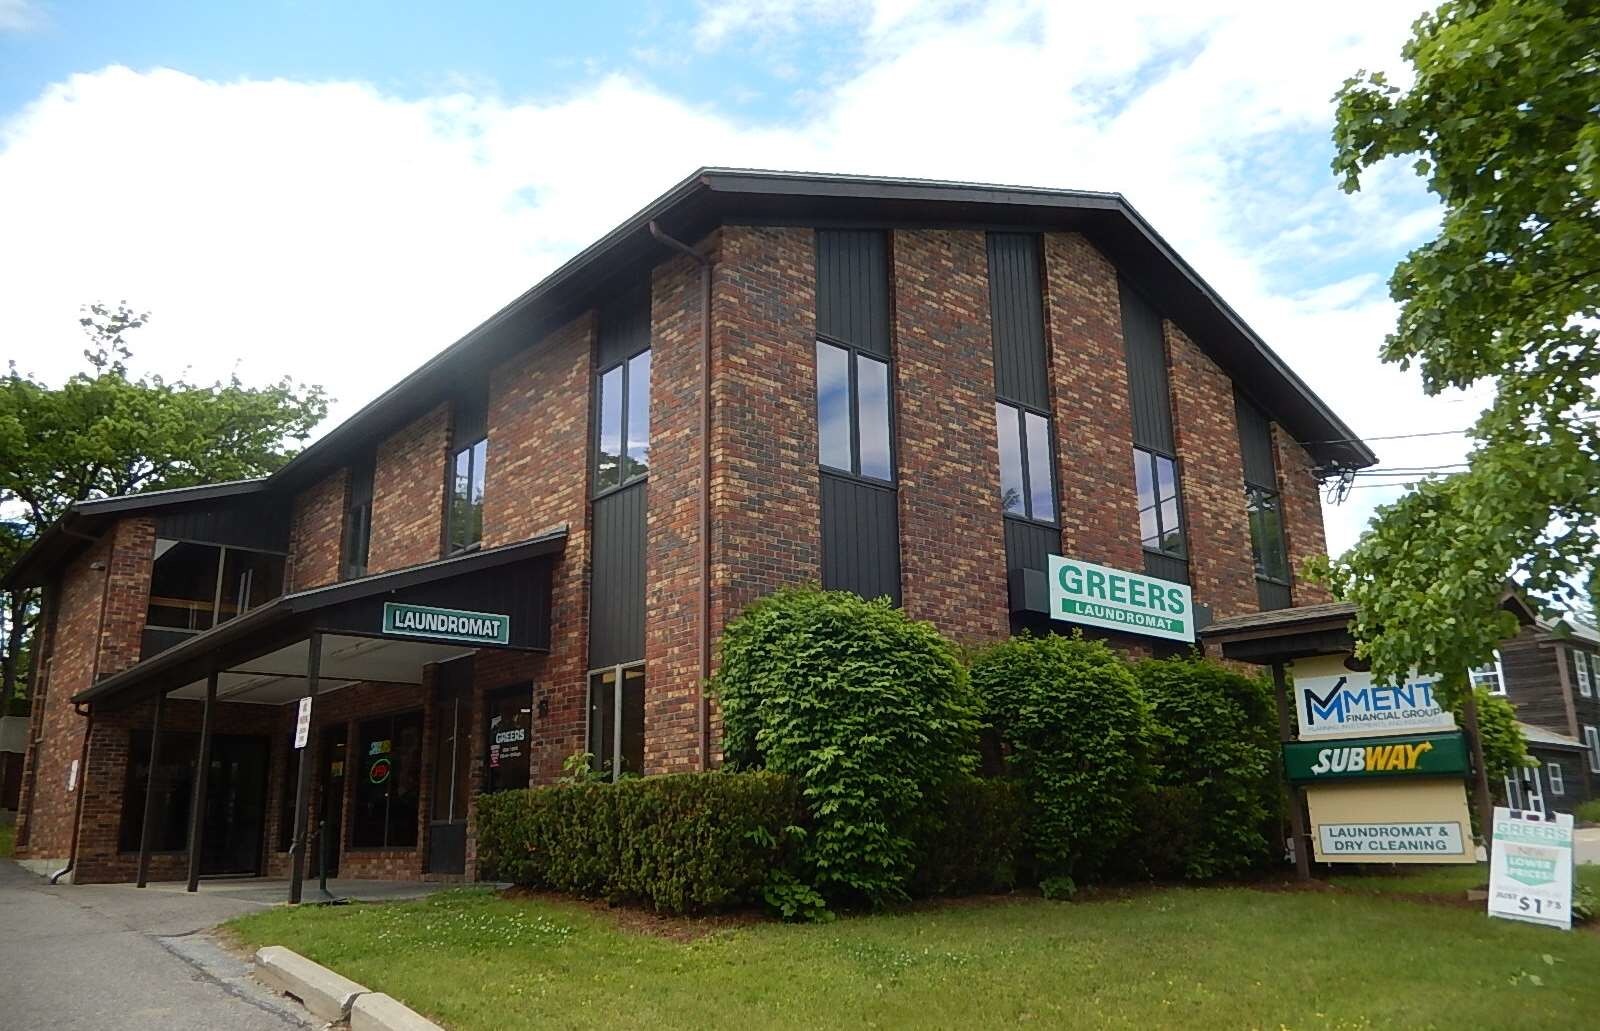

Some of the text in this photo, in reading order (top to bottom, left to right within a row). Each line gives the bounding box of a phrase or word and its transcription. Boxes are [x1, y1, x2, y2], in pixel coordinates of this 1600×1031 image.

[1058, 564, 1185, 615] GREERS
[395, 610, 500, 637] LAUNDROMAT
[1075, 602, 1173, 630] LAUNDROMAT
[1346, 707, 1441, 722] FINANCIAL GROUP
[495, 729, 524, 744] GREERS
[1311, 741, 1433, 775] SUBWAY
[1329, 826, 1449, 838] LAUNDROMAT &
[1497, 822, 1569, 838] GREERS
[1334, 839, 1447, 851] DRY CLEANING
